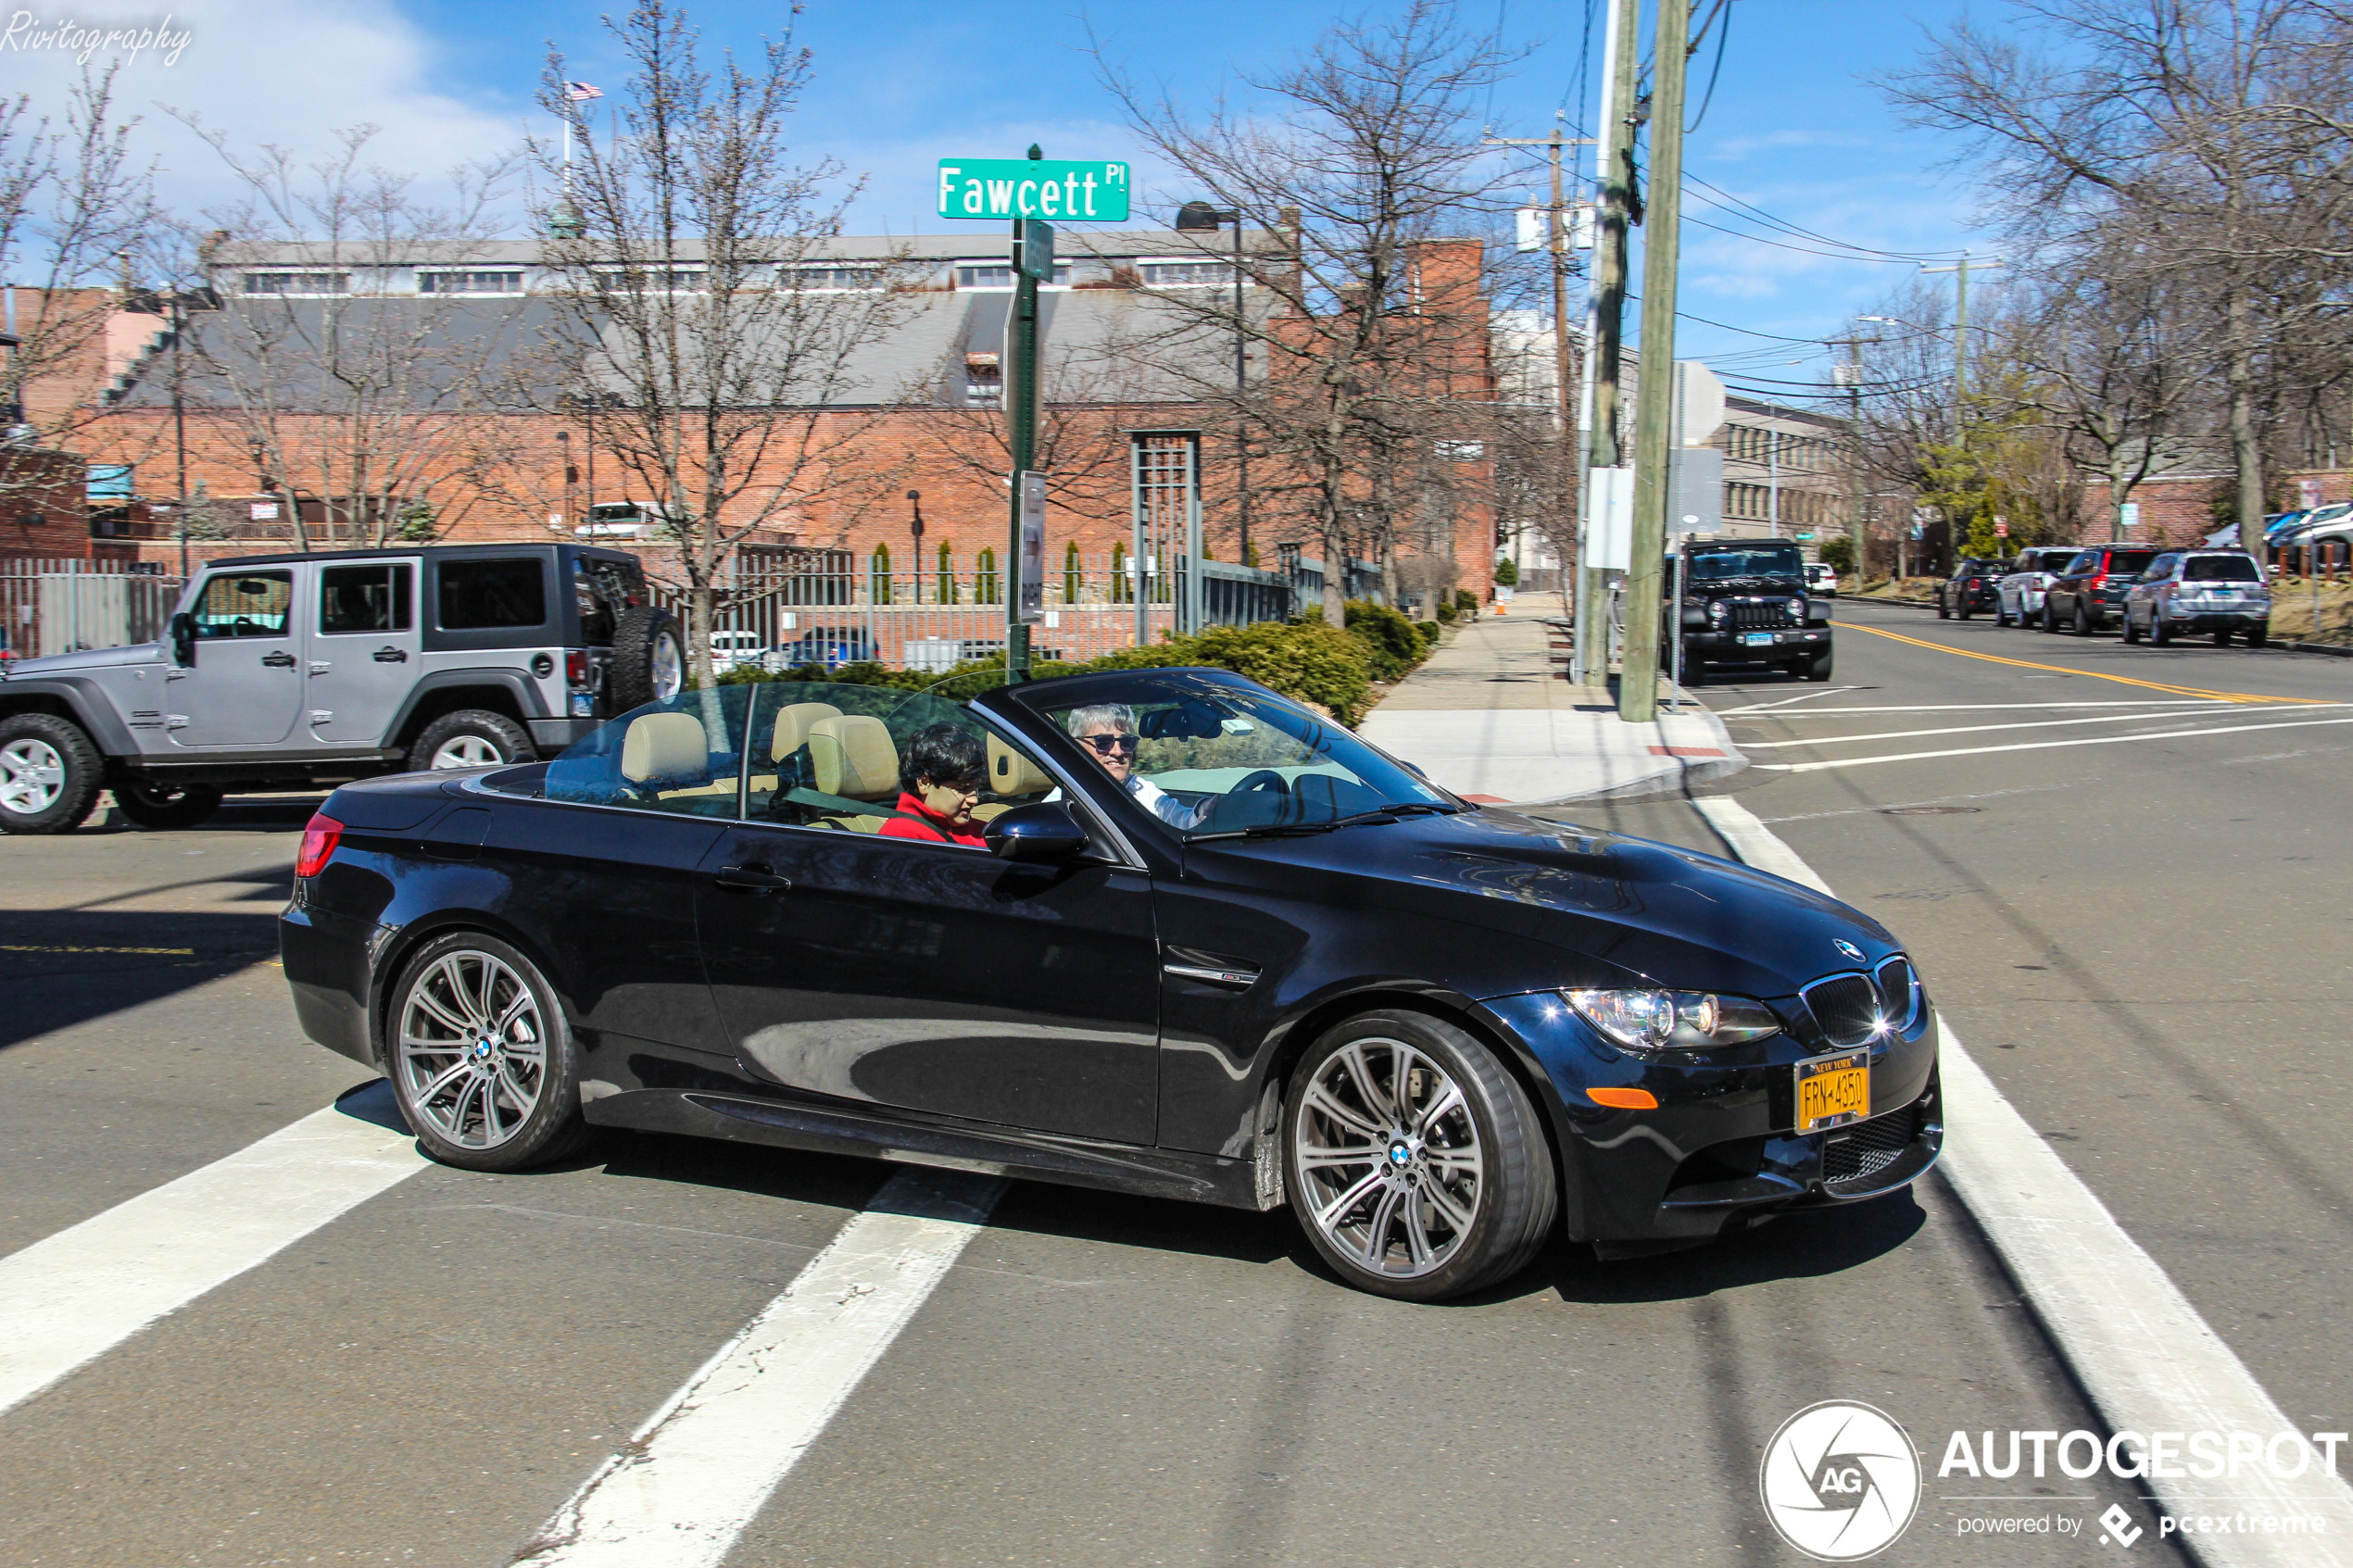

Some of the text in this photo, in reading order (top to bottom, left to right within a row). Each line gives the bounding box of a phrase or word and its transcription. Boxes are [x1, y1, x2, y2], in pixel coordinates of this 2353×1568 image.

[938, 164, 1126, 216] Fawcett Pl
[1815, 1058, 1852, 1074] NEW YORK
